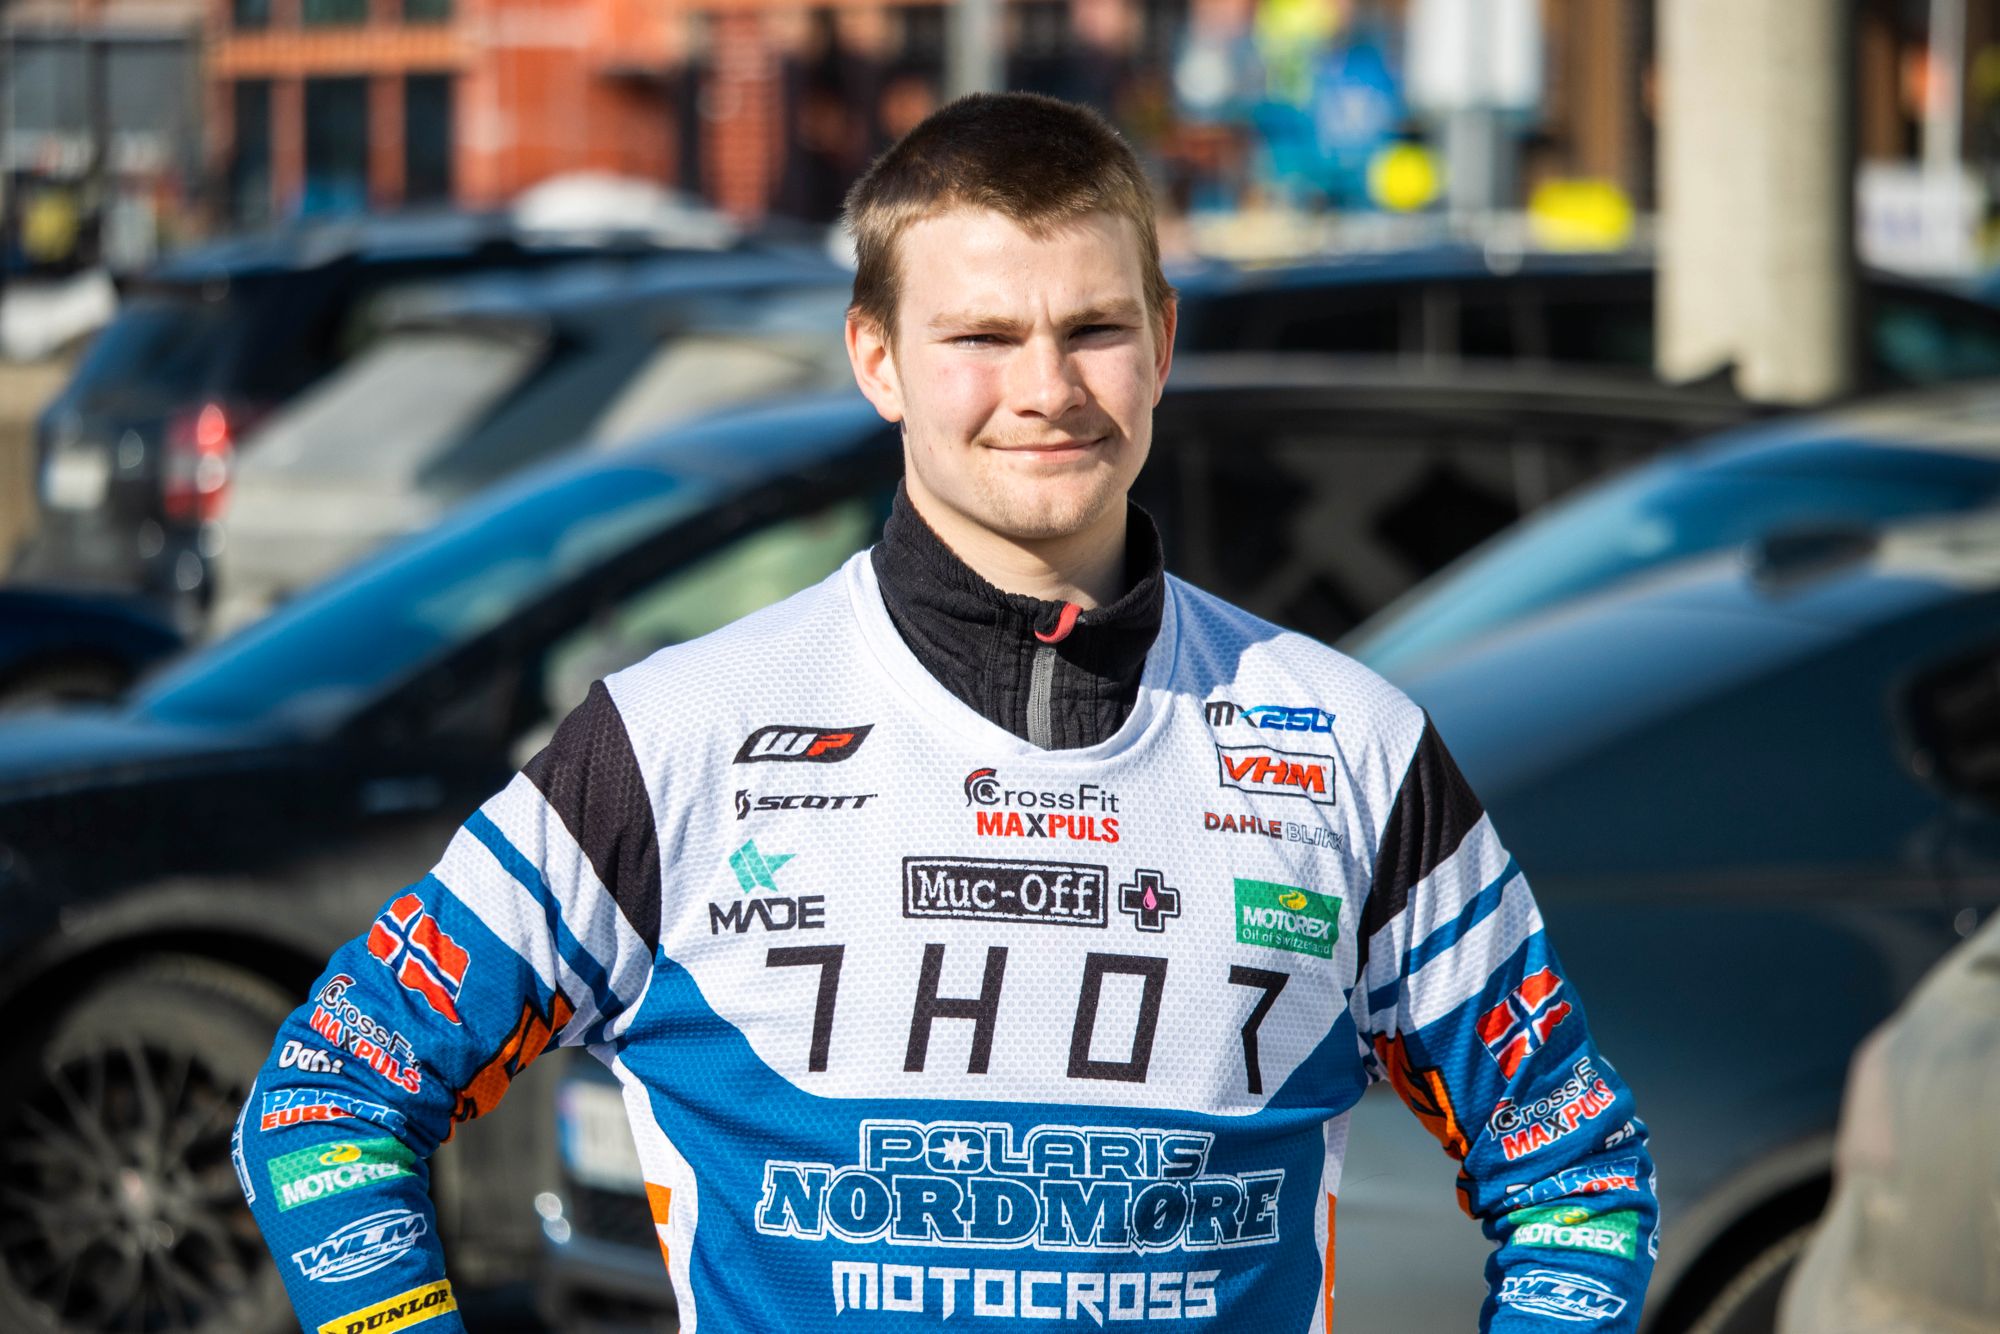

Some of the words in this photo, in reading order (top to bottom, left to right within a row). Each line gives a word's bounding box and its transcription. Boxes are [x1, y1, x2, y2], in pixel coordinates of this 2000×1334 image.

[966, 769, 1120, 813] CrossFit
[1222, 755, 1327, 793] VHM
[754, 794, 878, 810] SCOTT
[976, 811, 1120, 844] MAXPULS
[1204, 812, 1282, 839] DAHLE
[708, 895, 825, 935] MADE
[917, 870, 1095, 917] Muc-Off
[1242, 928, 1259, 940] Oil
[1262, 932, 1273, 943] of
[1243, 905, 1332, 940] MOTOREX
[309, 1005, 422, 1094] MAXPULS
[1487, 1056, 1598, 1140] CrossF
[1501, 1078, 1616, 1161] MAXPULS
[860, 1119, 1216, 1180] POLARIS
[754, 1158, 1286, 1257] NORDMØRE
[345, 1289, 449, 1334] DUNLOP
[832, 1260, 1222, 1327] MOTOCROSS
